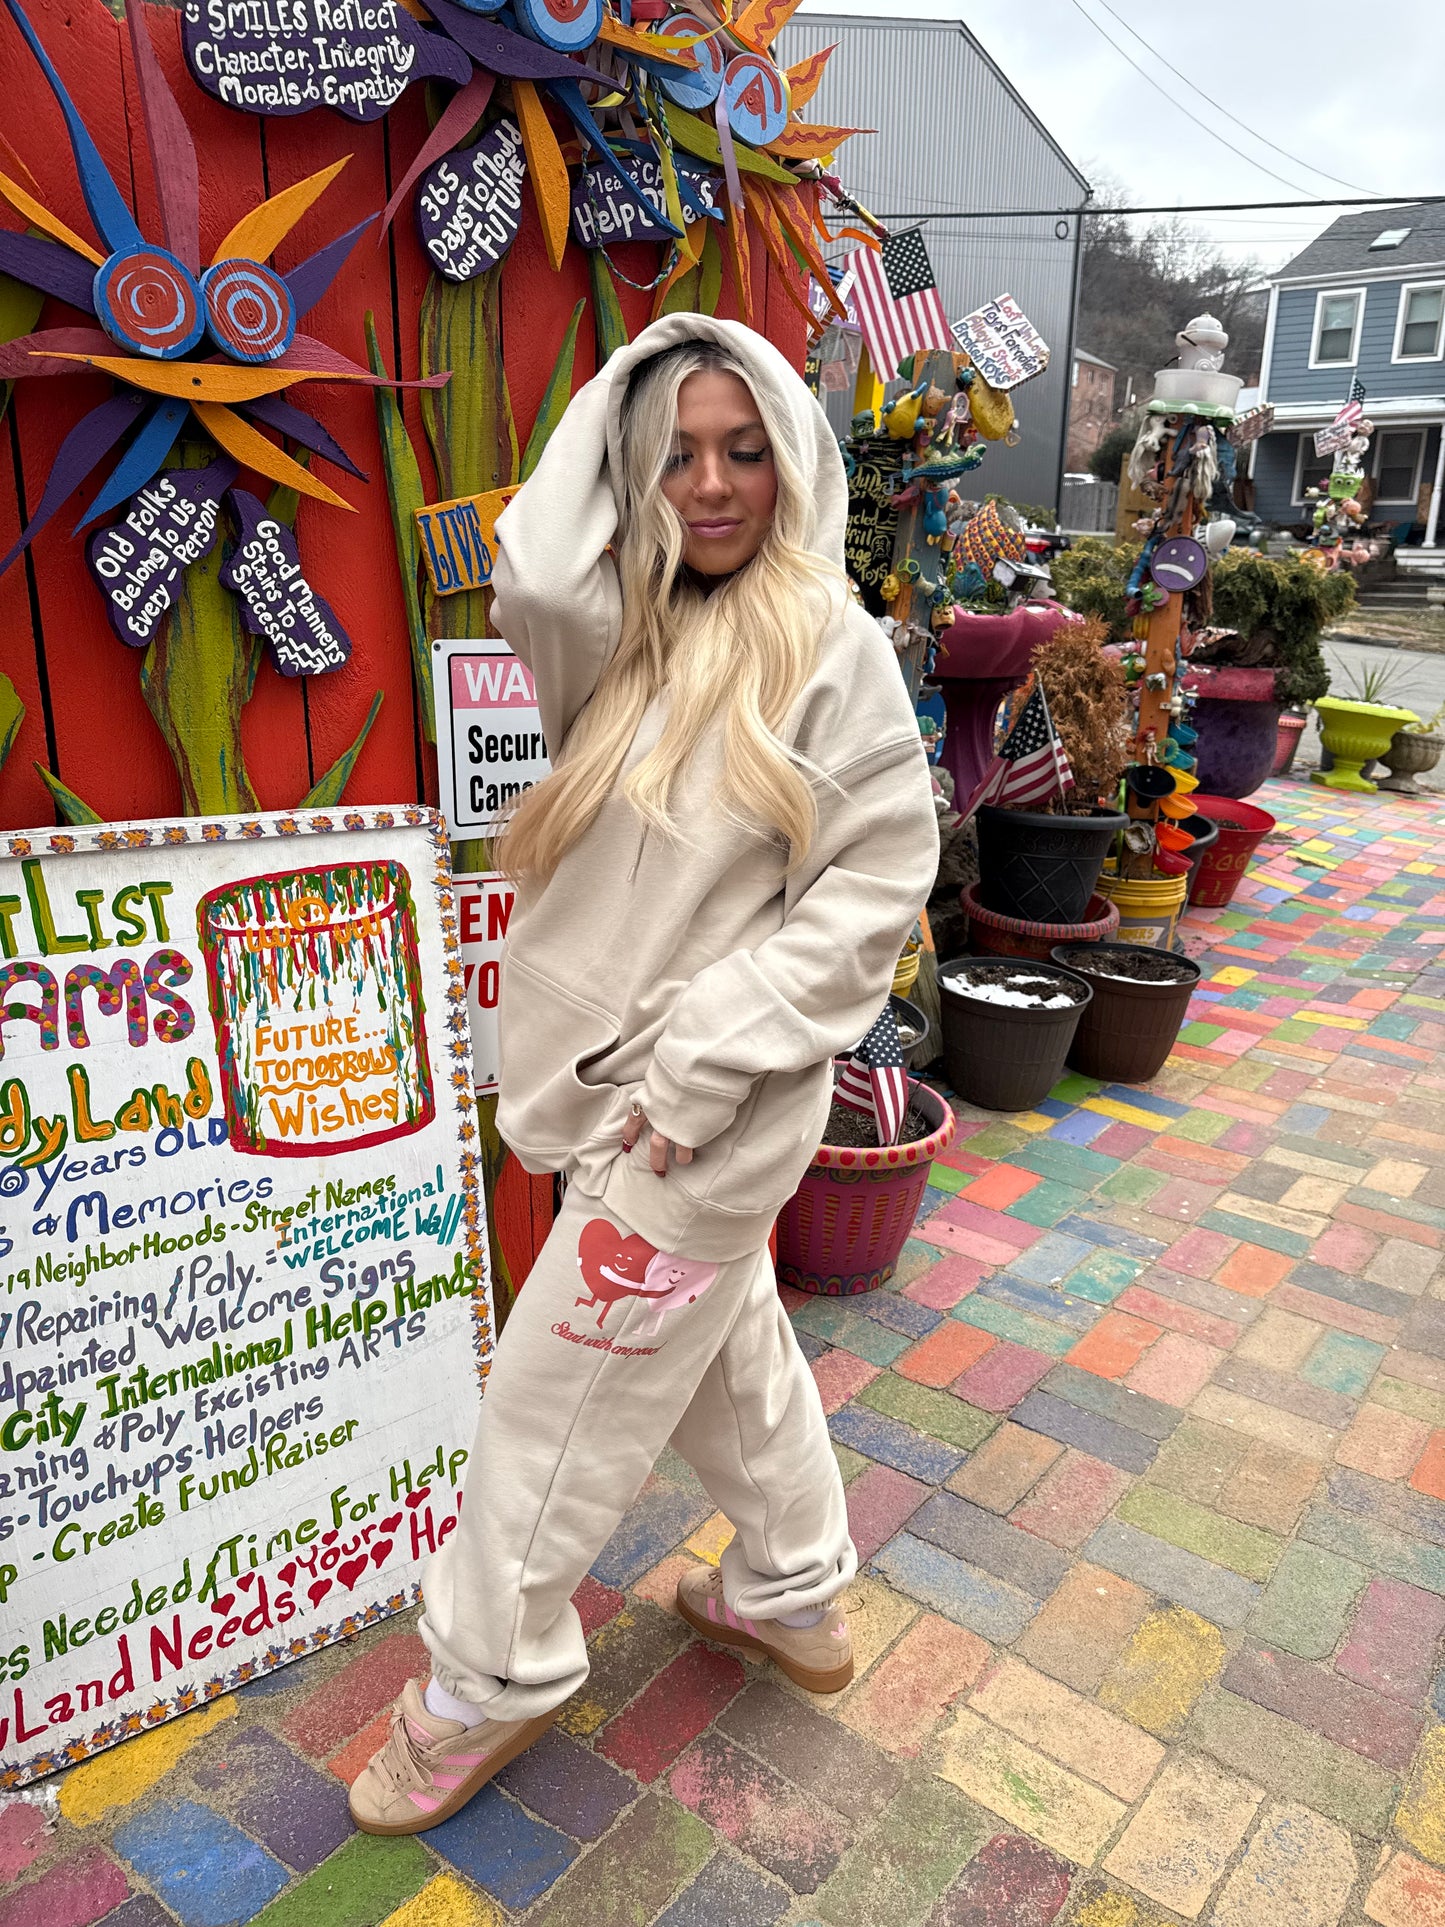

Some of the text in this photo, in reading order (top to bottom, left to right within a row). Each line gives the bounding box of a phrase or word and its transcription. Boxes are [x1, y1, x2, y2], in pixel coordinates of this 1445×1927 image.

[195, 36, 414, 76] Character, Integrity
[208, 0, 398, 32] SMILES Reflect
[218, 76, 302, 106] Morals
[323, 74, 409, 115] Empathy
[420, 162, 459, 222] 365
[428, 118, 523, 263] Days To Mould
[444, 157, 527, 281] Your FUTURE
[982, 301, 1009, 333] Toys
[95, 478, 177, 578] Old Folks
[111, 498, 198, 612] Belong To Us
[127, 583, 172, 638] Every
[172, 498, 220, 565] Person
[418, 500, 493, 593] LIVE
[232, 564, 287, 646] Success
[243, 541, 298, 629] Stairs To
[256, 520, 346, 664] Good Manners
[464, 662, 539, 703] WA
[255, 1017, 387, 1056] FUTURE...
[154, 1118, 228, 1157] OLD
[269, 1087, 399, 1137] Wishes
[66, 1177, 273, 1243] Memories
[275, 1164, 445, 1250] International
[284, 1193, 467, 1270] WELCOME Wall
[325, 1174, 397, 1211] Names
[17, 1290, 158, 1350] Repairing
[154, 1286, 313, 1350] Welcome
[320, 1250, 416, 1301] Signs
[0, 1390, 89, 1452] City
[305, 1300, 388, 1350] Help
[393, 1252, 480, 1318] Hands
[121, 1406, 186, 1453] Poly
[195, 1355, 331, 1423] Excisting
[338, 1311, 427, 1369] ARTS
[43, 1557, 191, 1663] Needed
[330, 1484, 381, 1530] For
[389, 1444, 469, 1503] Help
[150, 1576, 298, 1682] Needs
[295, 1523, 378, 1578] Your
